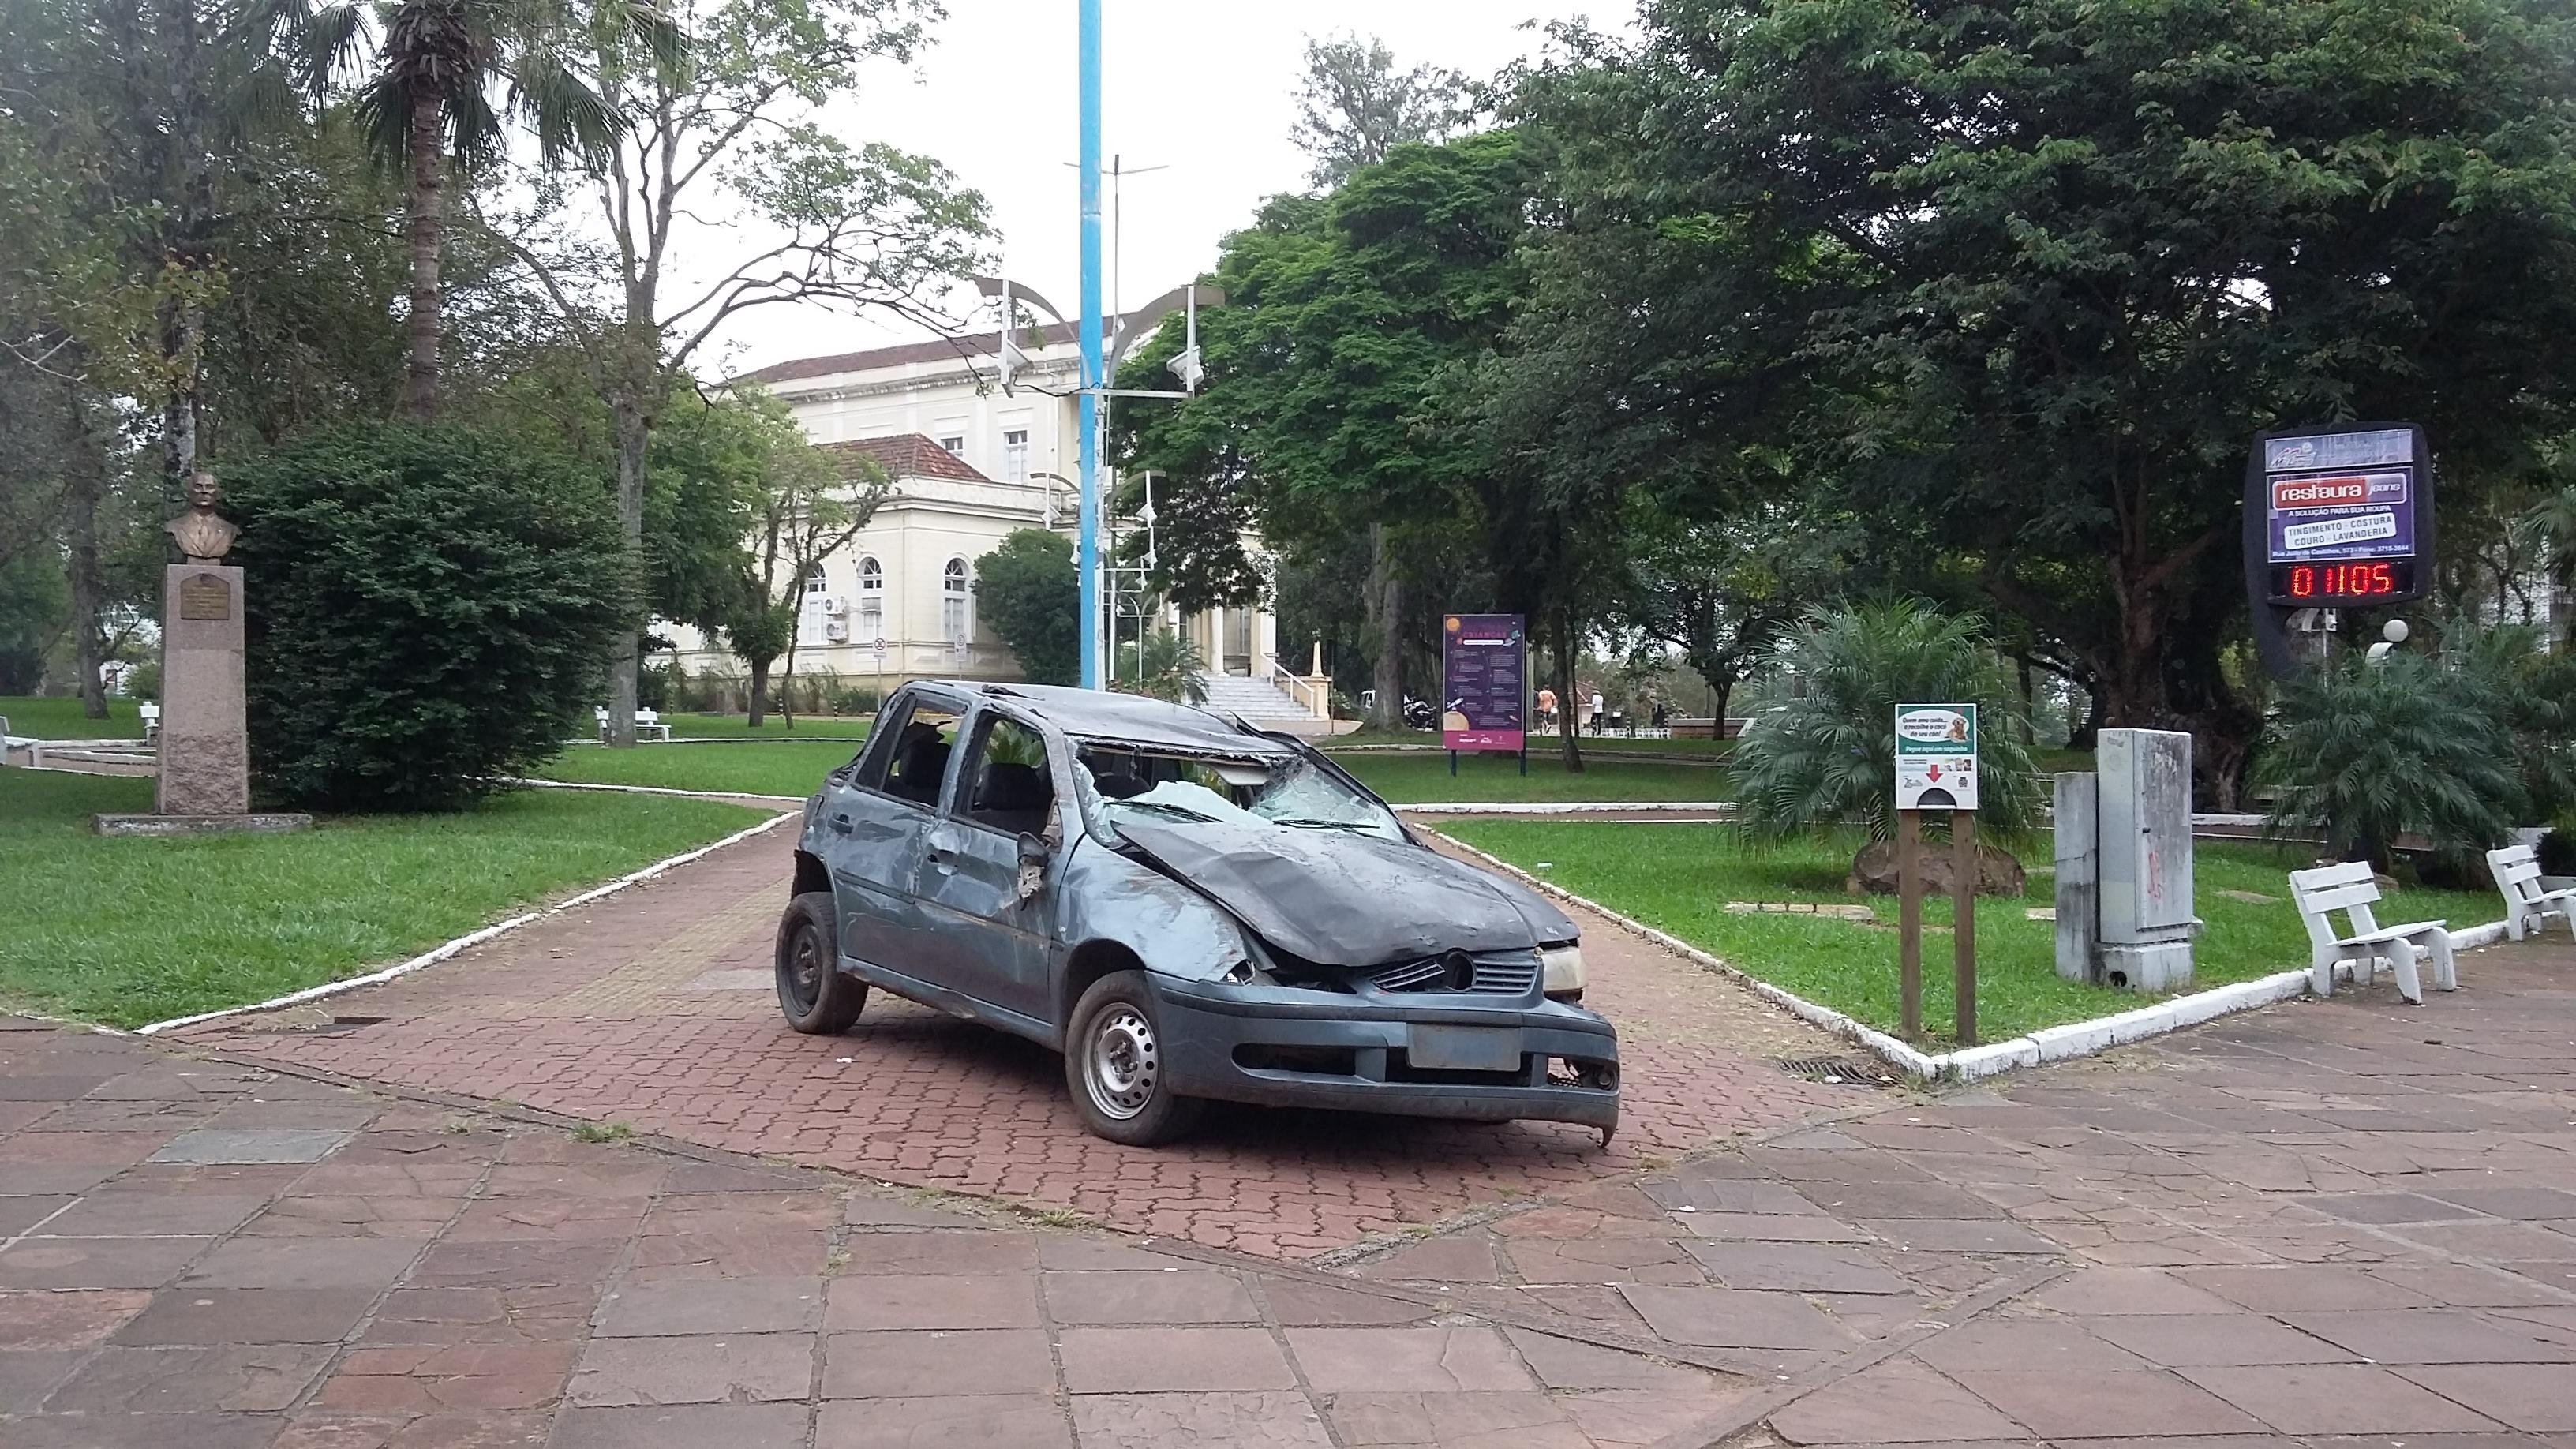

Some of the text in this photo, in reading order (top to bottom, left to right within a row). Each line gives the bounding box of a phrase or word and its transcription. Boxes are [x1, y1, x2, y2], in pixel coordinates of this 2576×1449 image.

[2281, 483, 2401, 501] restaura jeans
[2295, 507, 2329, 518] SOLUÇÃO
[2288, 522, 2342, 537] TINGIMENTO
[2350, 516, 2392, 529] COSTURA
[2294, 535, 2325, 546] COURO
[2333, 527, 2388, 541] LAVANDERIA
